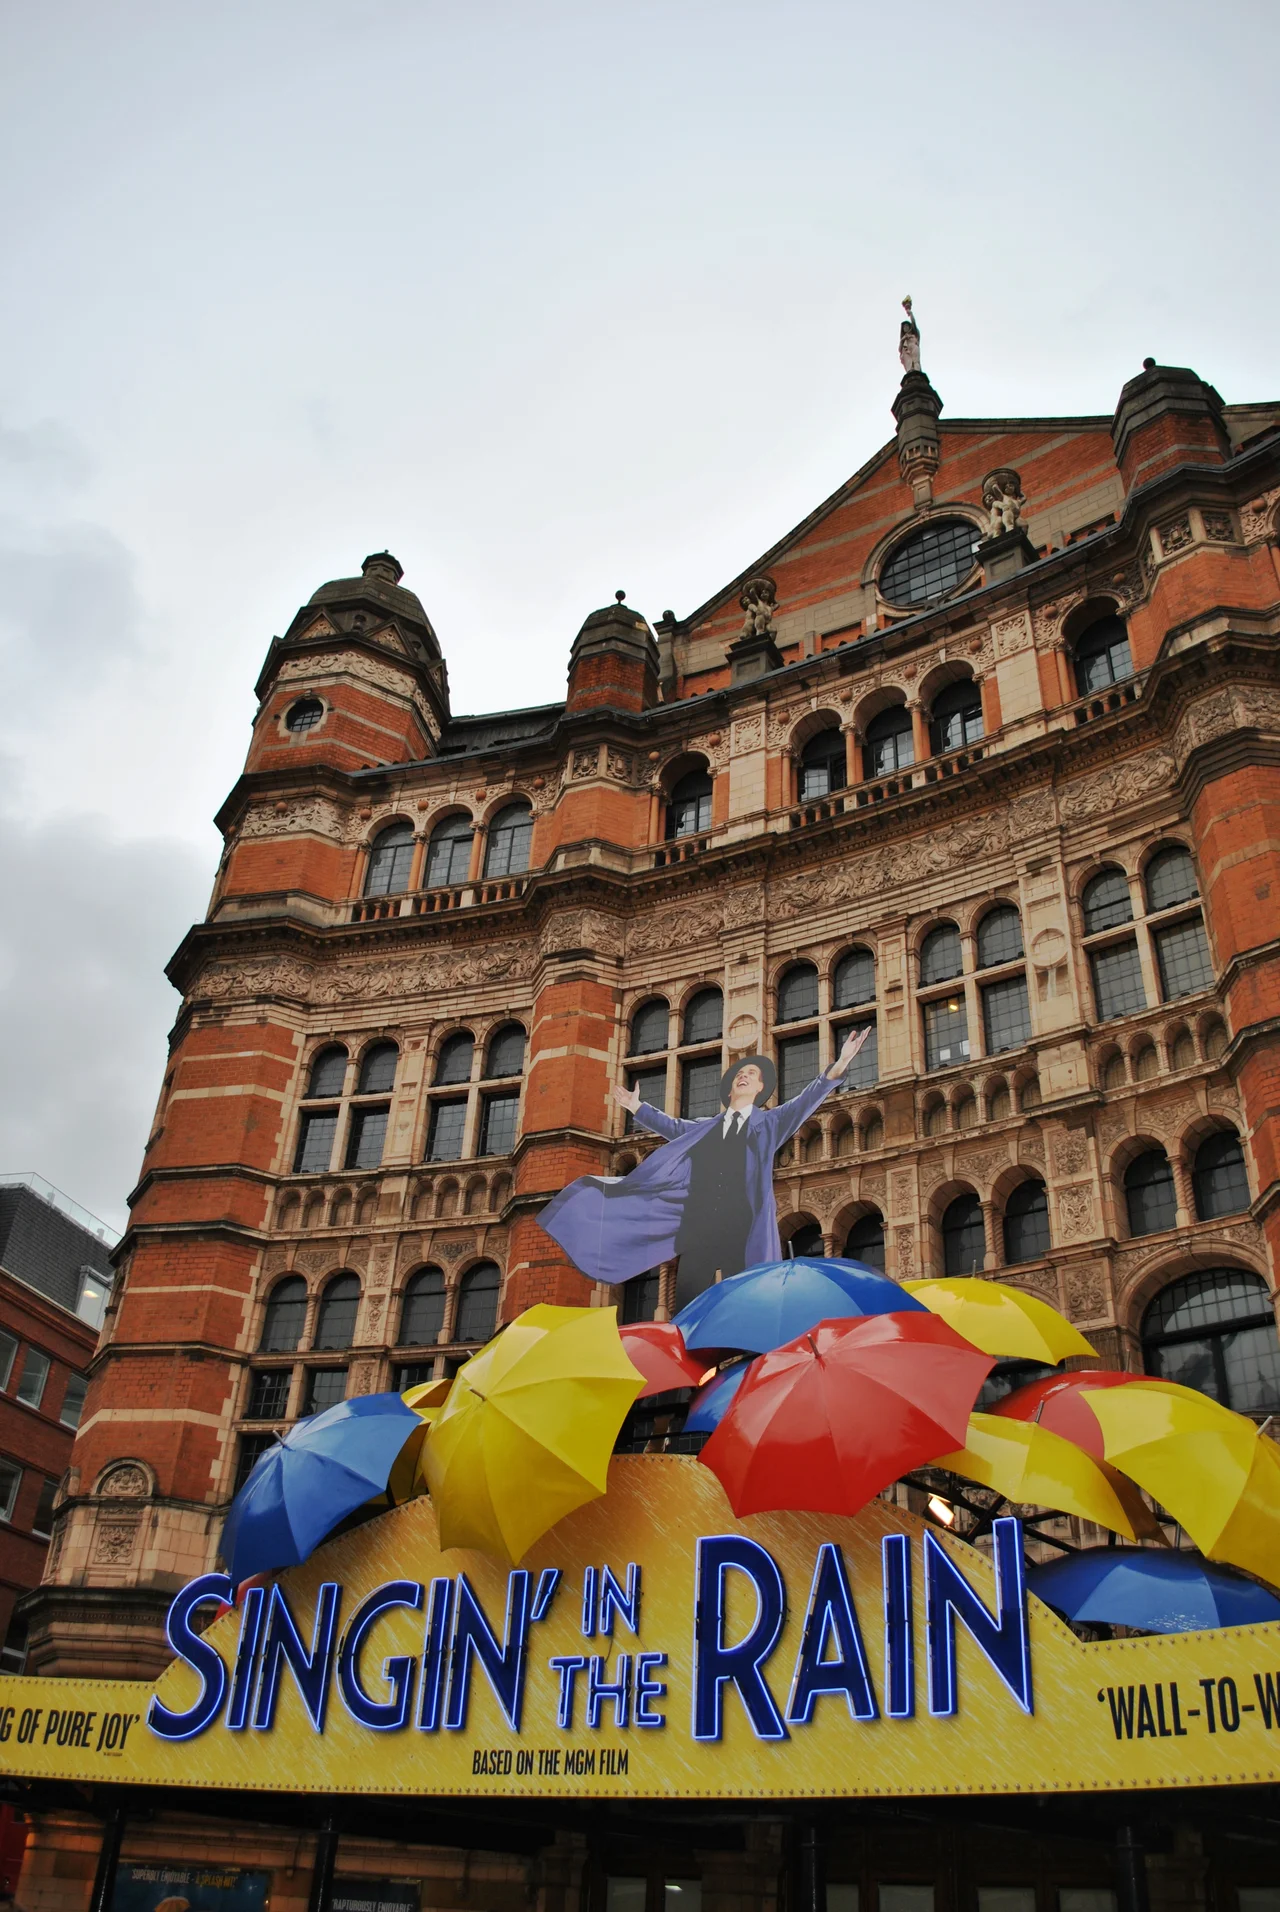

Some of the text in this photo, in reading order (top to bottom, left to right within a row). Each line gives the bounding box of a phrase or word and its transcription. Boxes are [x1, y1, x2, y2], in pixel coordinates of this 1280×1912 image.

[147, 1516, 1035, 1742] SINGIN' IN THE RAIN
[17, 1707, 43, 1744] OF
[43, 1709, 97, 1748] PURE
[96, 1712, 140, 1752] JOY’
[472, 1748, 629, 1776] BASED ON THE MGM FILM
